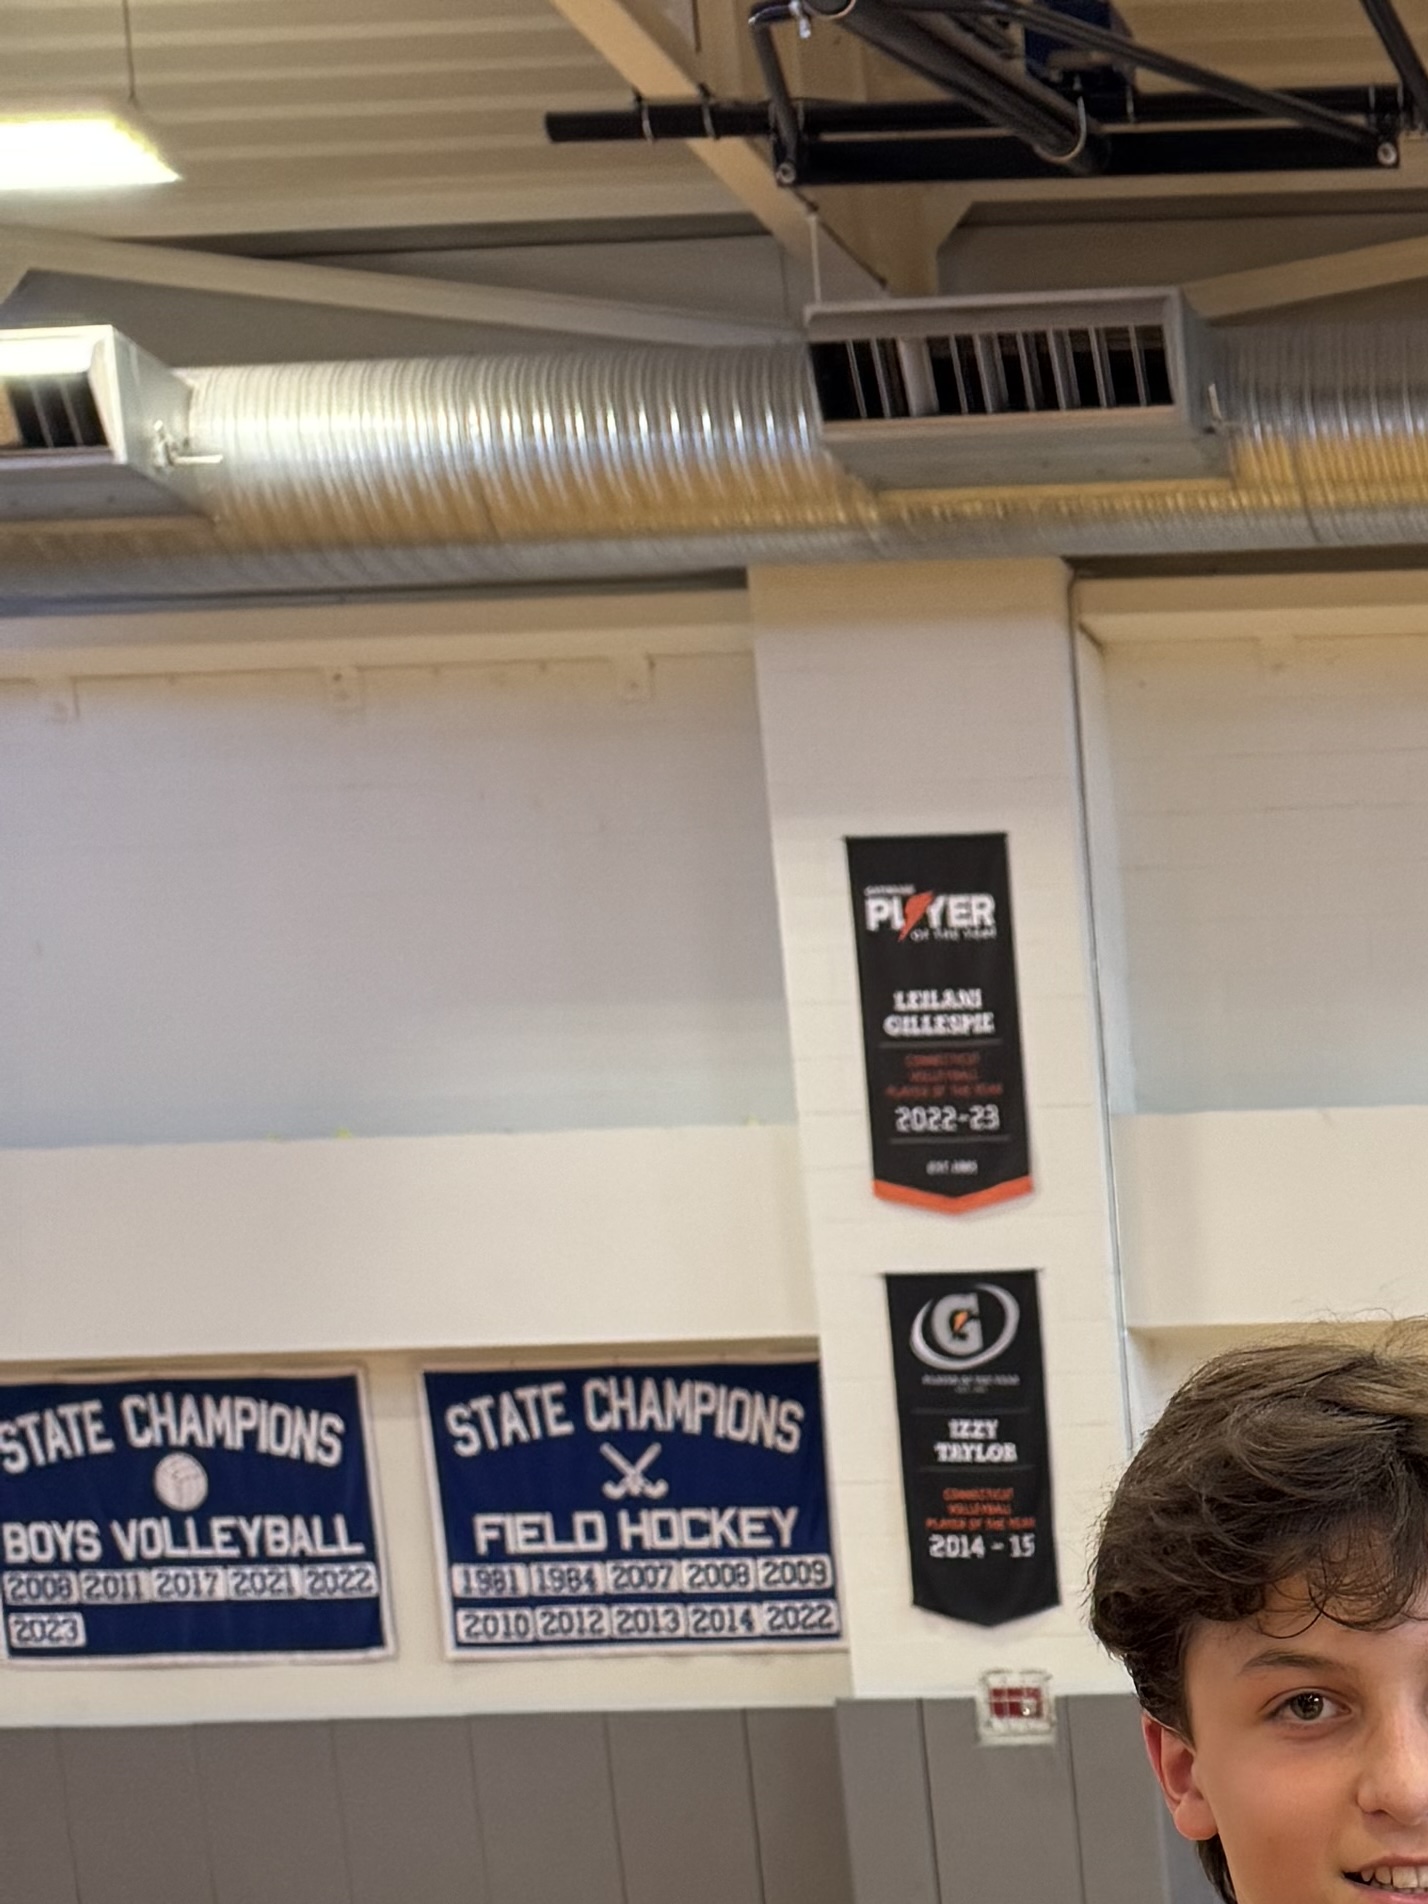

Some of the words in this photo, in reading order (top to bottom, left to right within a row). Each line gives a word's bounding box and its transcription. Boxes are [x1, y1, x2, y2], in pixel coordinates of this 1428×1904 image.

[894, 1104, 1000, 1133] 2022-23
[0, 1399, 116, 1474] STATE
[120, 1392, 346, 1469] CHAMPIONS
[445, 1381, 575, 1458] STATE
[582, 1376, 805, 1456] CHAMPIONS
[3, 1518, 103, 1564] BOYS
[111, 1514, 366, 1562] VOLLEYBALL
[473, 1510, 609, 1556] FIELD
[617, 1506, 800, 1551] HOCKEY
[84, 1572, 144, 1599] 2011
[156, 1570, 220, 1598] 2017
[233, 1568, 296, 1597] 2021
[307, 1566, 374, 1595] 2022
[611, 1562, 674, 1590] 2007
[762, 1558, 829, 1587] 2009
[14, 1614, 79, 1643] 2023
[464, 1613, 530, 1641] 2010
[540, 1610, 602, 1638] 2012
[616, 1608, 681, 1636] 2013
[691, 1606, 755, 1634] 2014
[767, 1604, 834, 1632] 2022
